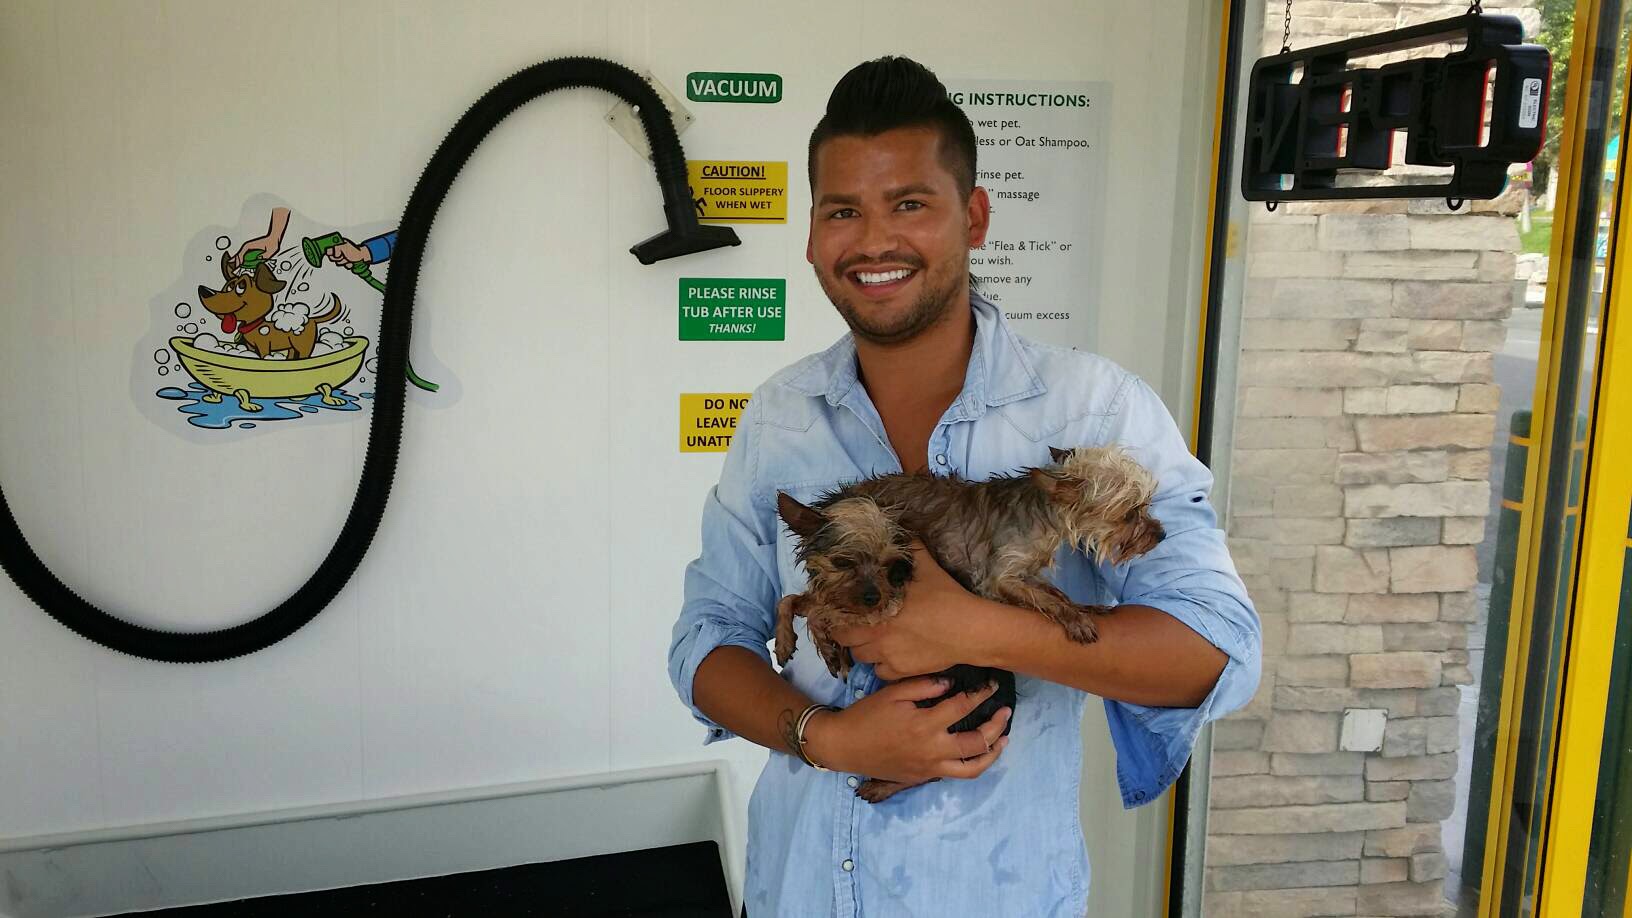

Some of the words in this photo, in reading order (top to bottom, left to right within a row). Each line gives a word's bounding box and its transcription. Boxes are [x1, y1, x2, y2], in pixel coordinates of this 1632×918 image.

[691, 79, 777, 97] VACUUM
[969, 93, 1090, 108] INSTRUCTIONS:
[977, 119, 998, 128] wet
[1001, 120, 1021, 130] pet.
[976, 136, 995, 146] less
[998, 138, 1012, 146] or
[1015, 136, 1036, 147] Oat
[702, 165, 765, 177] CAUTION!
[975, 170, 1002, 180] rinse
[1004, 171, 1024, 182] pet.
[703, 187, 737, 196] FLOOR
[739, 187, 784, 196] SLIPPERY
[997, 191, 1040, 201] massage
[715, 200, 747, 209] WHEN
[750, 201, 772, 209] WET
[1018, 240, 1026, 251] &
[1059, 243, 1072, 251] or
[987, 255, 1014, 265] wish.
[976, 276, 1011, 284] emove
[1014, 276, 1032, 287] any
[688, 287, 735, 299] PLEASE
[739, 287, 777, 299] RINSE
[682, 306, 709, 318] TUB
[712, 306, 754, 318] AFTER
[757, 307, 782, 318] USE
[1005, 312, 1033, 320] cuum
[1036, 311, 1070, 320] excess
[709, 323, 756, 333] THANKS!
[704, 399, 725, 410] DO
[696, 417, 737, 429] LEAVE
[686, 436, 732, 447] UNATT
